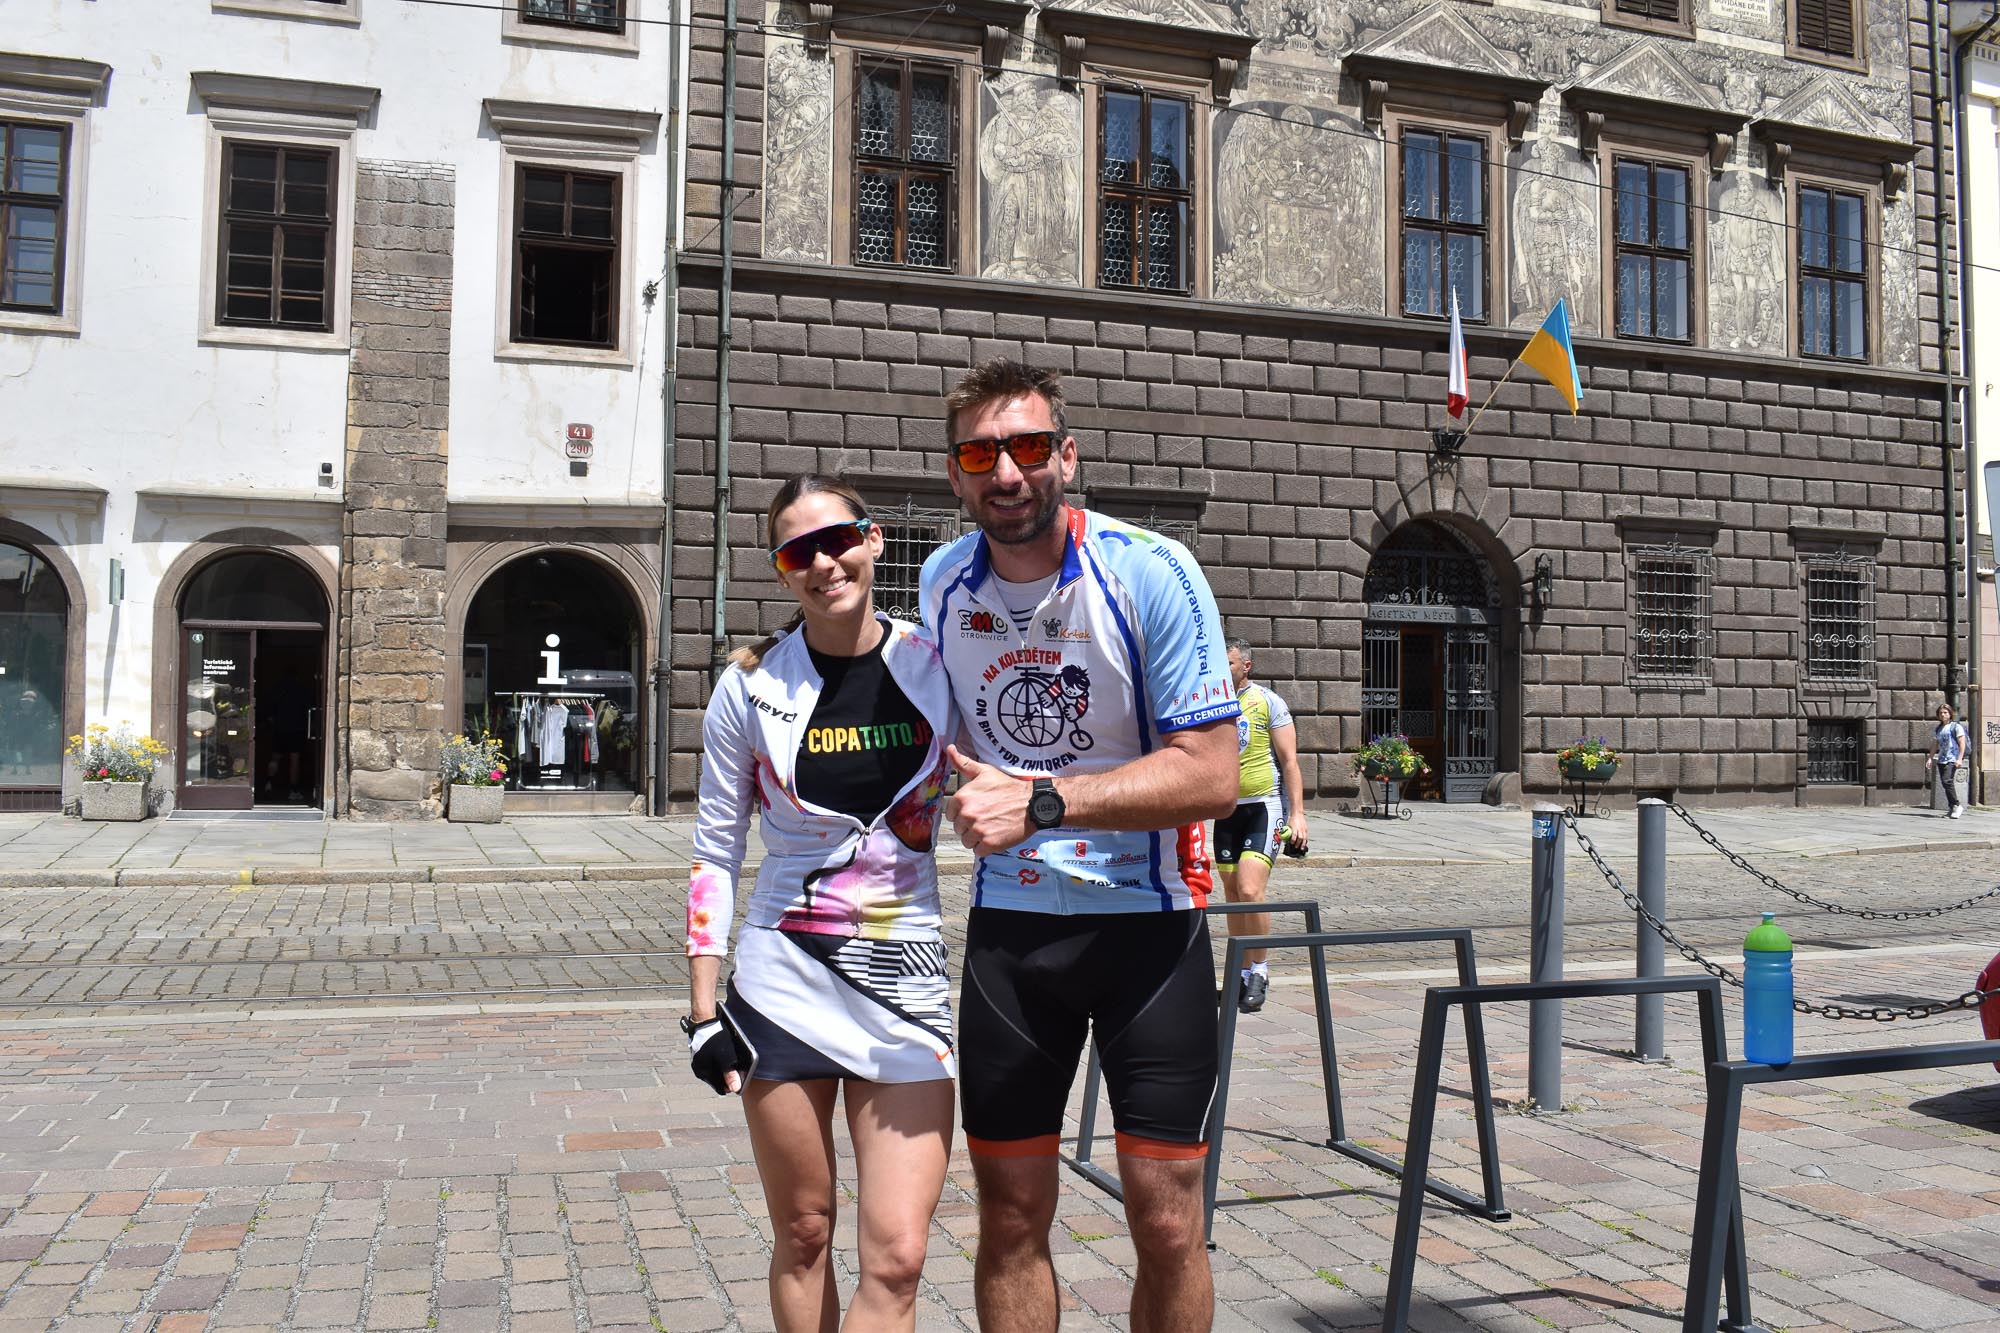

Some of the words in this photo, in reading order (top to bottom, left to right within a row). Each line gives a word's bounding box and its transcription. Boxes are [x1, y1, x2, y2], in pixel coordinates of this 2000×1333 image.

[573, 426, 587, 438] 41
[570, 443, 589, 455] 290
[957, 609, 1009, 634] SMO
[982, 664, 1001, 683] NA
[997, 649, 1024, 670] KOLE
[1024, 646, 1062, 666] DĚTEM
[1196, 644, 1212, 676] kraj
[975, 698, 988, 717] ON
[1171, 714, 1192, 726] TOP
[1193, 703, 1239, 722] CENTRUM
[978, 720, 1000, 746] BIKE
[998, 745, 1021, 766] FOR
[1020, 751, 1079, 772] CHILDREN
